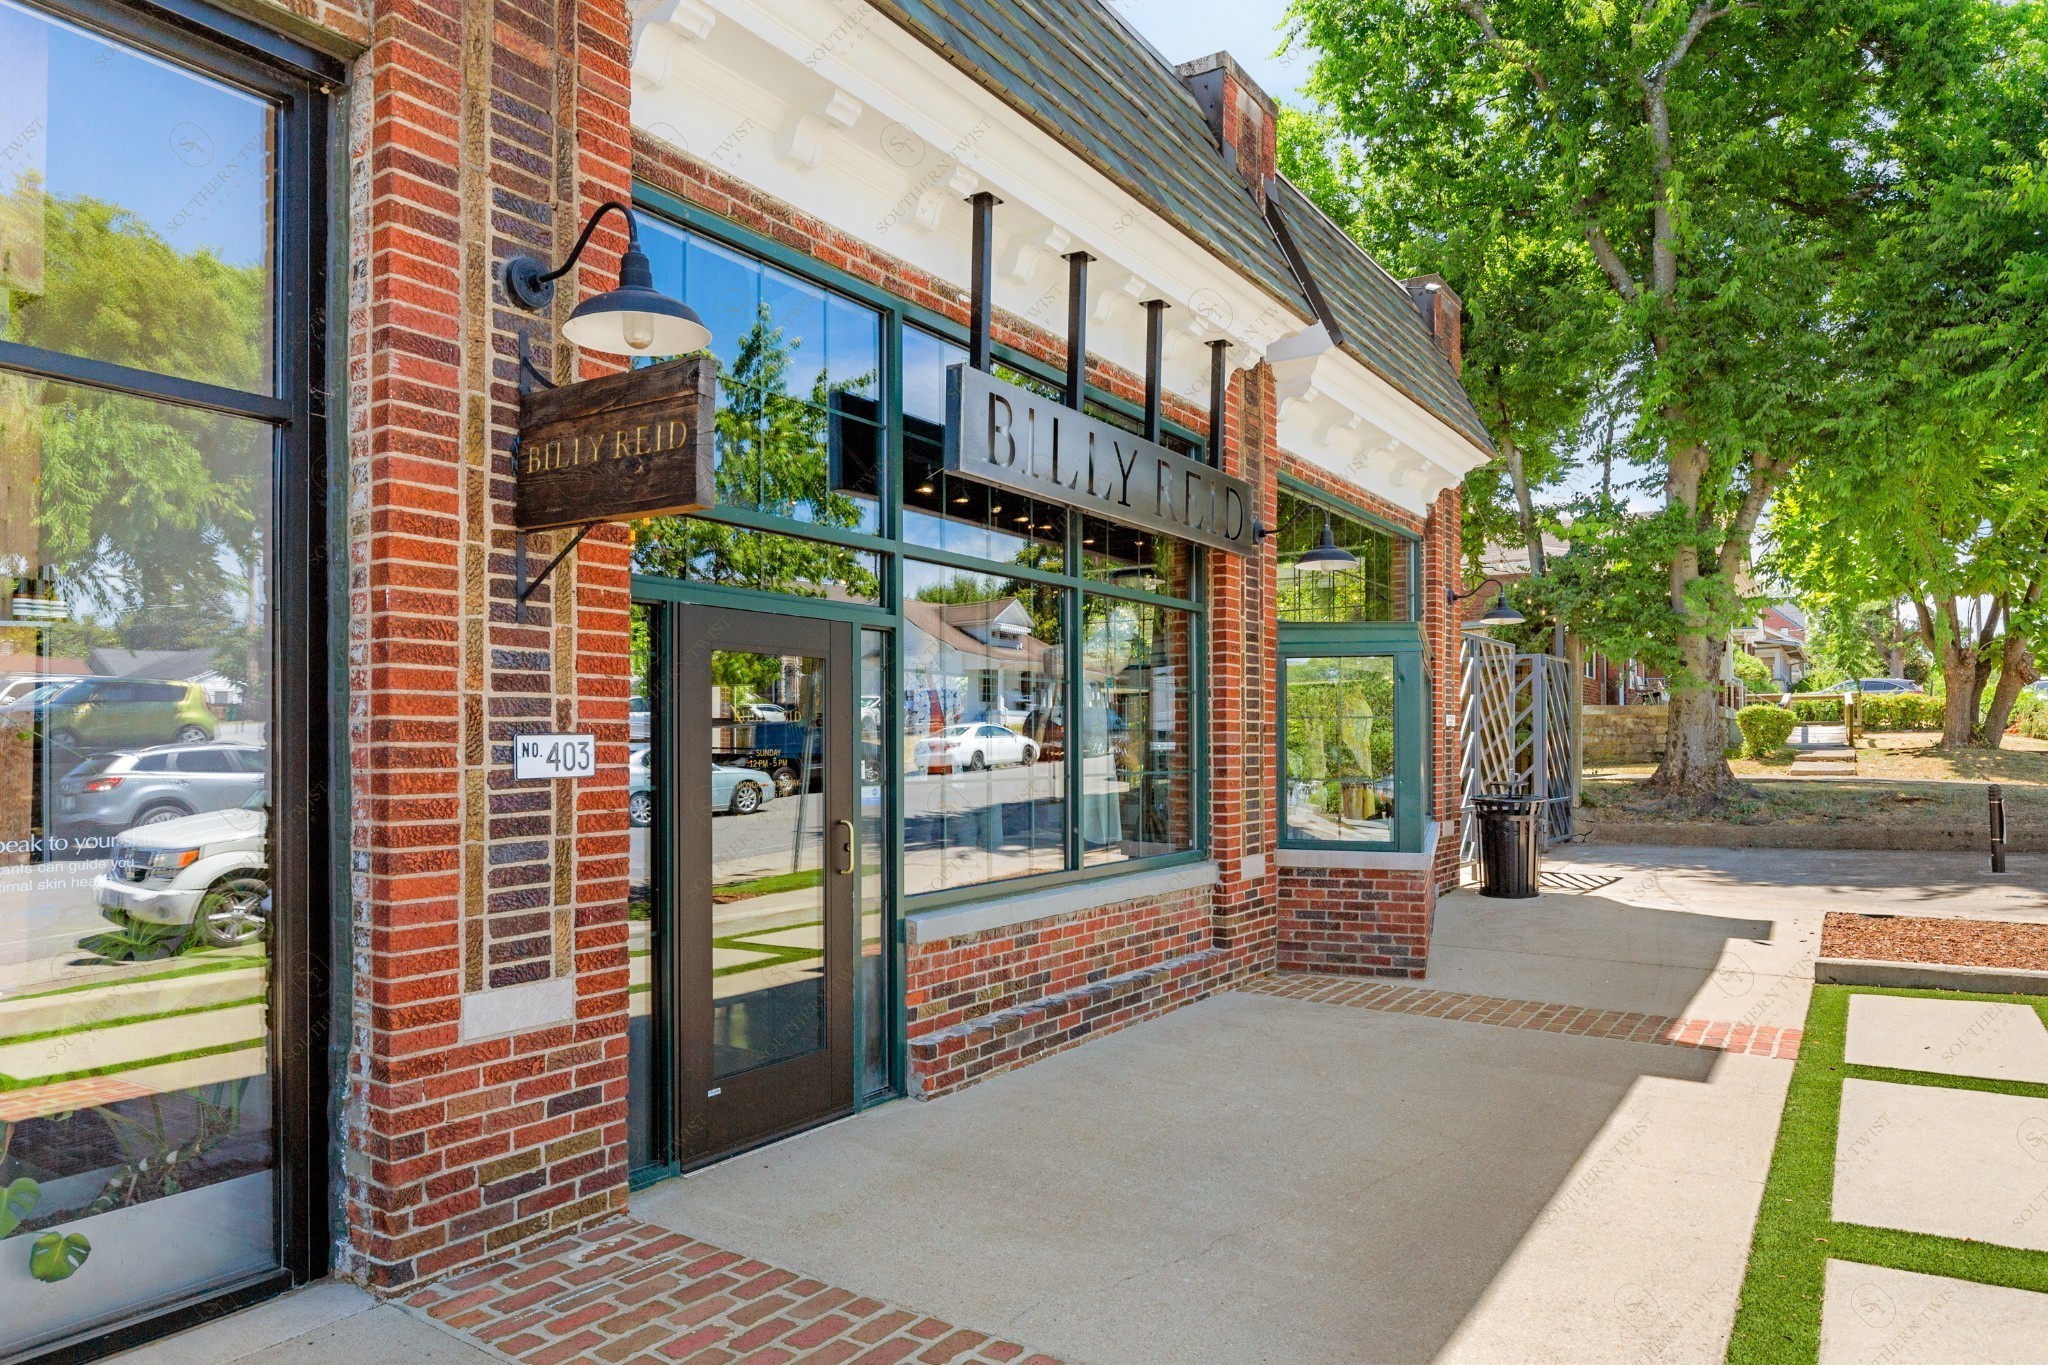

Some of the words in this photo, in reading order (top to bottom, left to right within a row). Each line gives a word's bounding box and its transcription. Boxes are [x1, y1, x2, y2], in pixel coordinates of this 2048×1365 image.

[527, 434, 605, 474] BILLY
[614, 420, 688, 459] REID
[981, 391, 1138, 507] BILLY
[1153, 458, 1243, 541] REID
[522, 742, 543, 758] NO.
[546, 742, 590, 772] 403
[756, 749, 782, 757] SUNDAY
[759, 759, 769, 767] PM
[778, 759, 788, 767] PM
[48, 836, 69, 851] to
[74, 834, 117, 855] your
[37, 862, 64, 873] can
[68, 858, 106, 874] guide
[37, 878, 66, 890] skin
